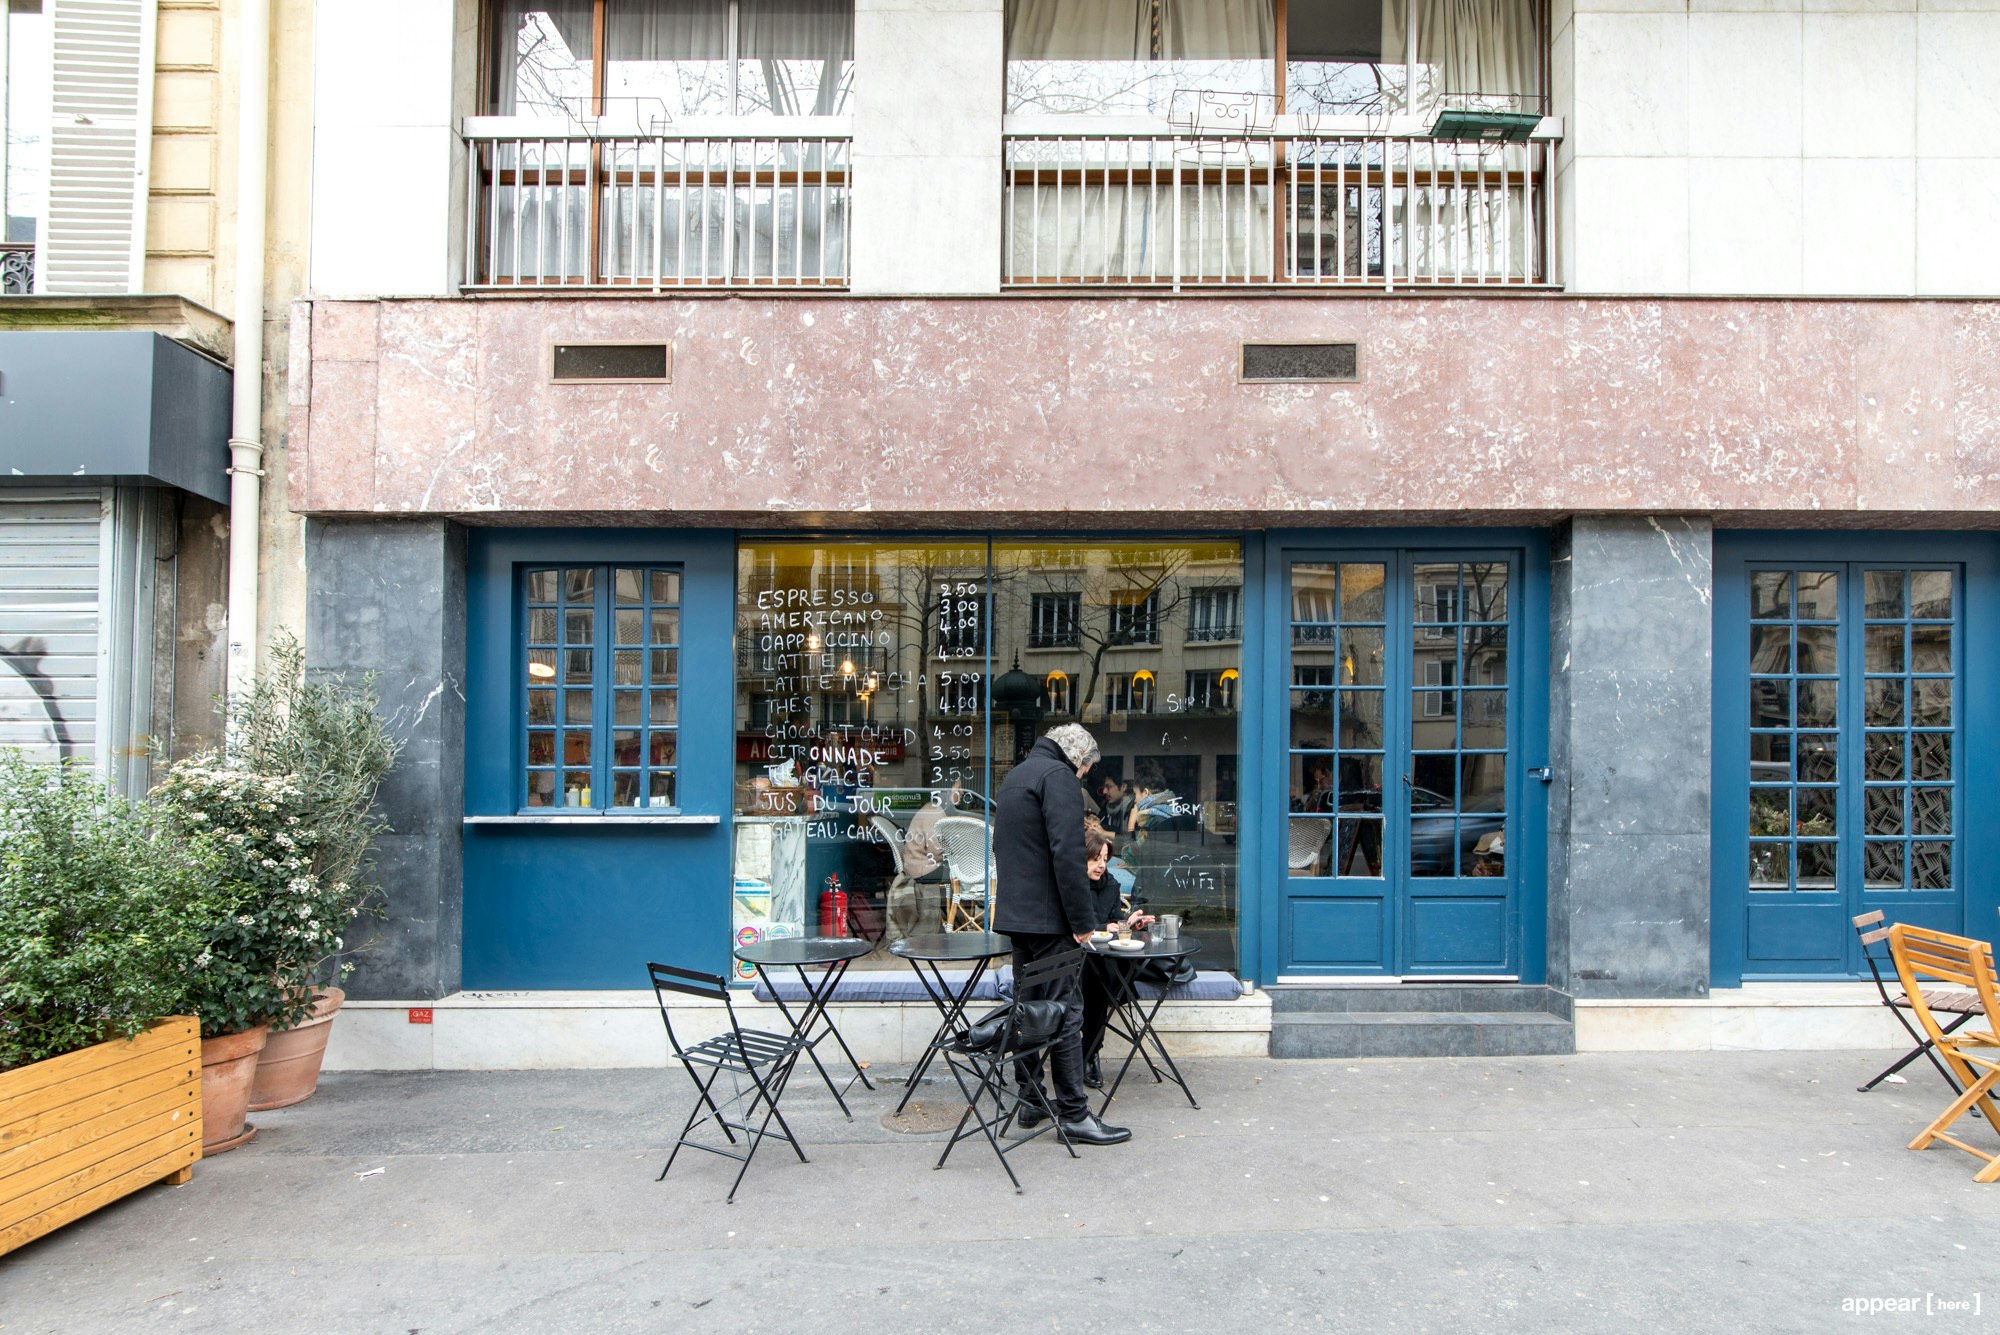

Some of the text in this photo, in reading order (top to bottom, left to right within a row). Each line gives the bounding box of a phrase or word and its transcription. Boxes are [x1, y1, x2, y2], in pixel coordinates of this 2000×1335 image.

[757, 582, 978, 610] ESPRESSO 2.50
[761, 598, 979, 631] AMERICANO 3.00
[761, 617, 977, 652] CAPPCCINO 4.00
[763, 644, 974, 671] LATTE 4.00
[763, 670, 980, 697] LATTE MATCHA 5.00
[939, 696, 977, 713] 4.00
[933, 725, 974, 740] 4.00
[767, 743, 889, 767] CITRONNADE
[930, 745, 971, 761] 3.50
[931, 766, 975, 783] 3.50
[761, 790, 974, 817] JUS DU JOUR 5.00
